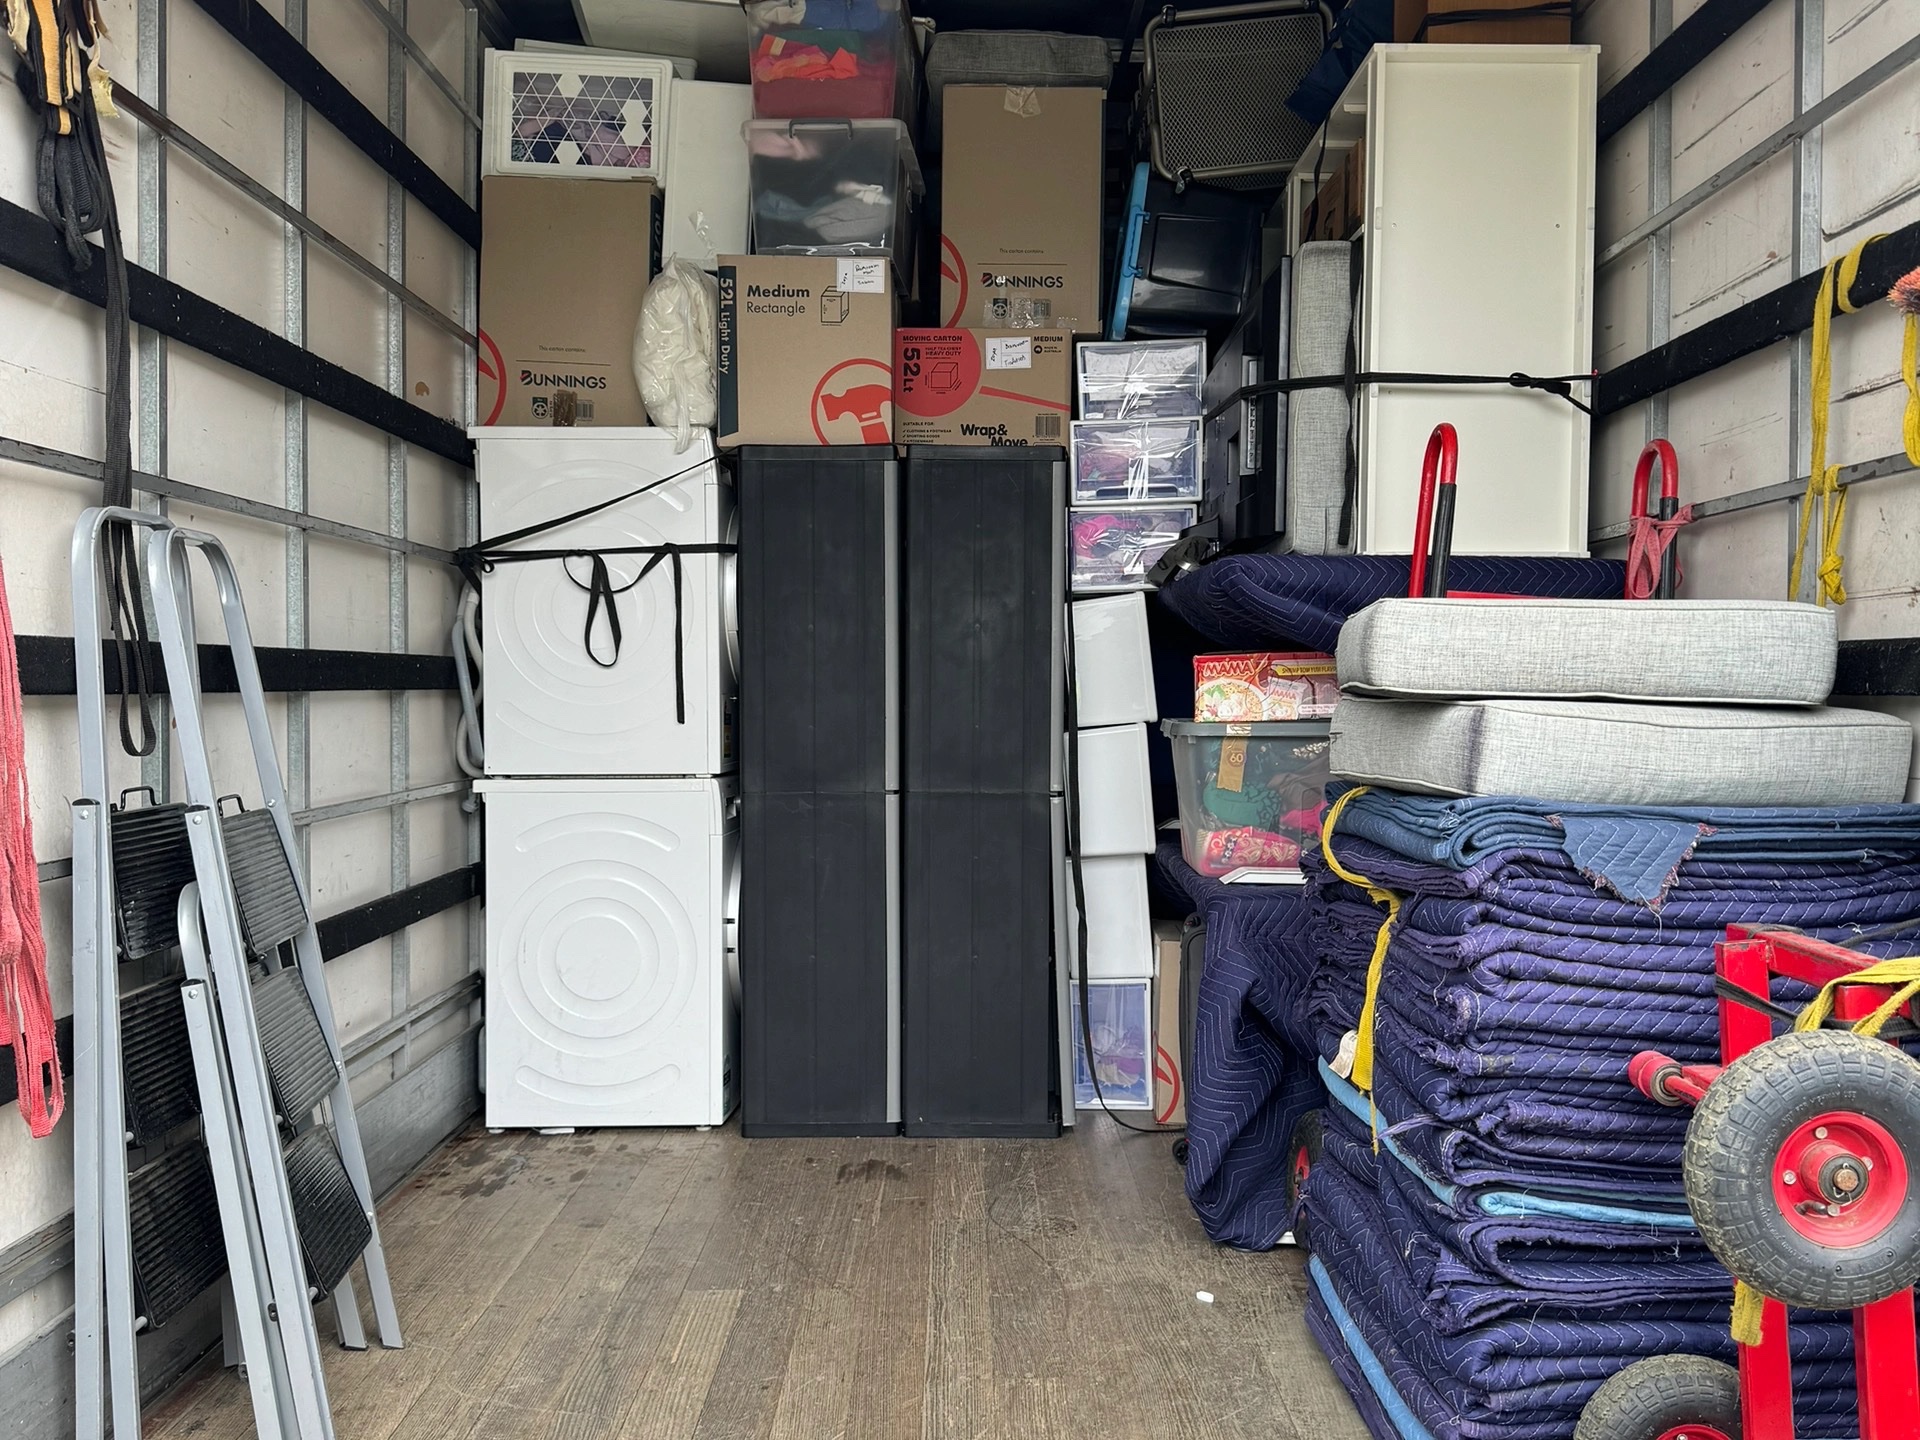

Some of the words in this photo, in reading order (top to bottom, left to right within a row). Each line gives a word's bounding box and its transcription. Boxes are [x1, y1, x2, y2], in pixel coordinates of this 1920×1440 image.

[981, 272, 1064, 288] BUNNINGS
[720, 278, 734, 309] 52L
[747, 284, 810, 298] Medium
[746, 300, 806, 317] Rectangle
[719, 312, 731, 342] Light
[719, 345, 731, 374] Duty
[520, 369, 607, 390] BUNNINGS
[991, 436, 1029, 447] Move
[1203, 660, 1254, 677] MAMA
[1230, 753, 1244, 763] 60
